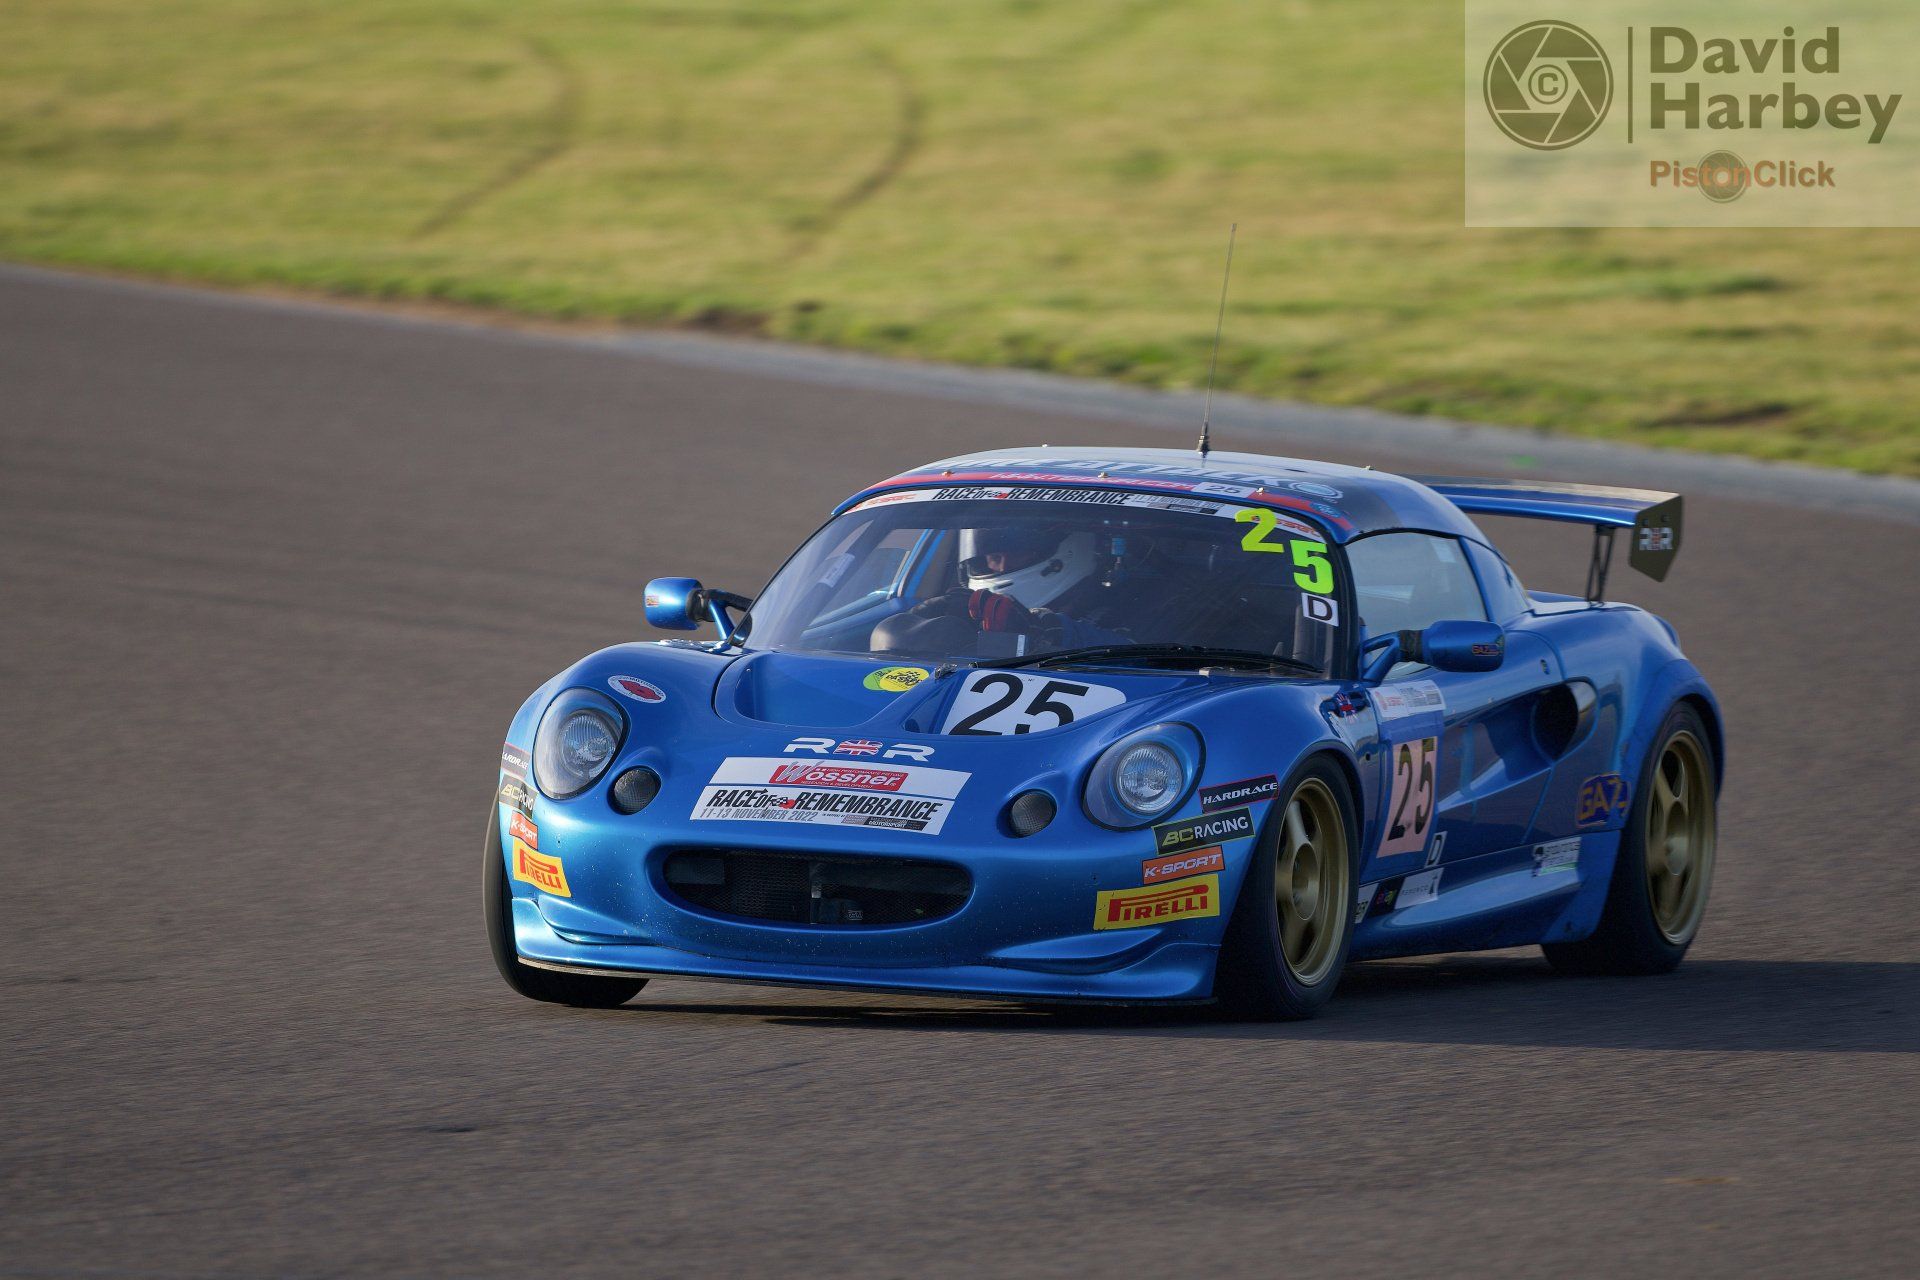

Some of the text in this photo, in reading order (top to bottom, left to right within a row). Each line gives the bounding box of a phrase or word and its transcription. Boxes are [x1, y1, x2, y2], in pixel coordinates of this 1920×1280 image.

[1006, 488, 1131, 505] REMEMBRANCE
[1204, 485, 1240, 494] 25
[1307, 595, 1333, 621] D
[949, 673, 1090, 736] 25
[1203, 782, 1278, 805] HARDRACE
[1387, 738, 1436, 841] 25
[700, 808, 819, 822] 11-13 NOVEMBER 2022
[706, 789, 764, 808] RACE
[792, 791, 943, 821] REMEMBRANCE
[1428, 834, 1443, 865] D
[519, 848, 562, 889] PIRELLI
[1145, 854, 1222, 878] K-SPORT
[1107, 884, 1209, 922] PIRELLI
